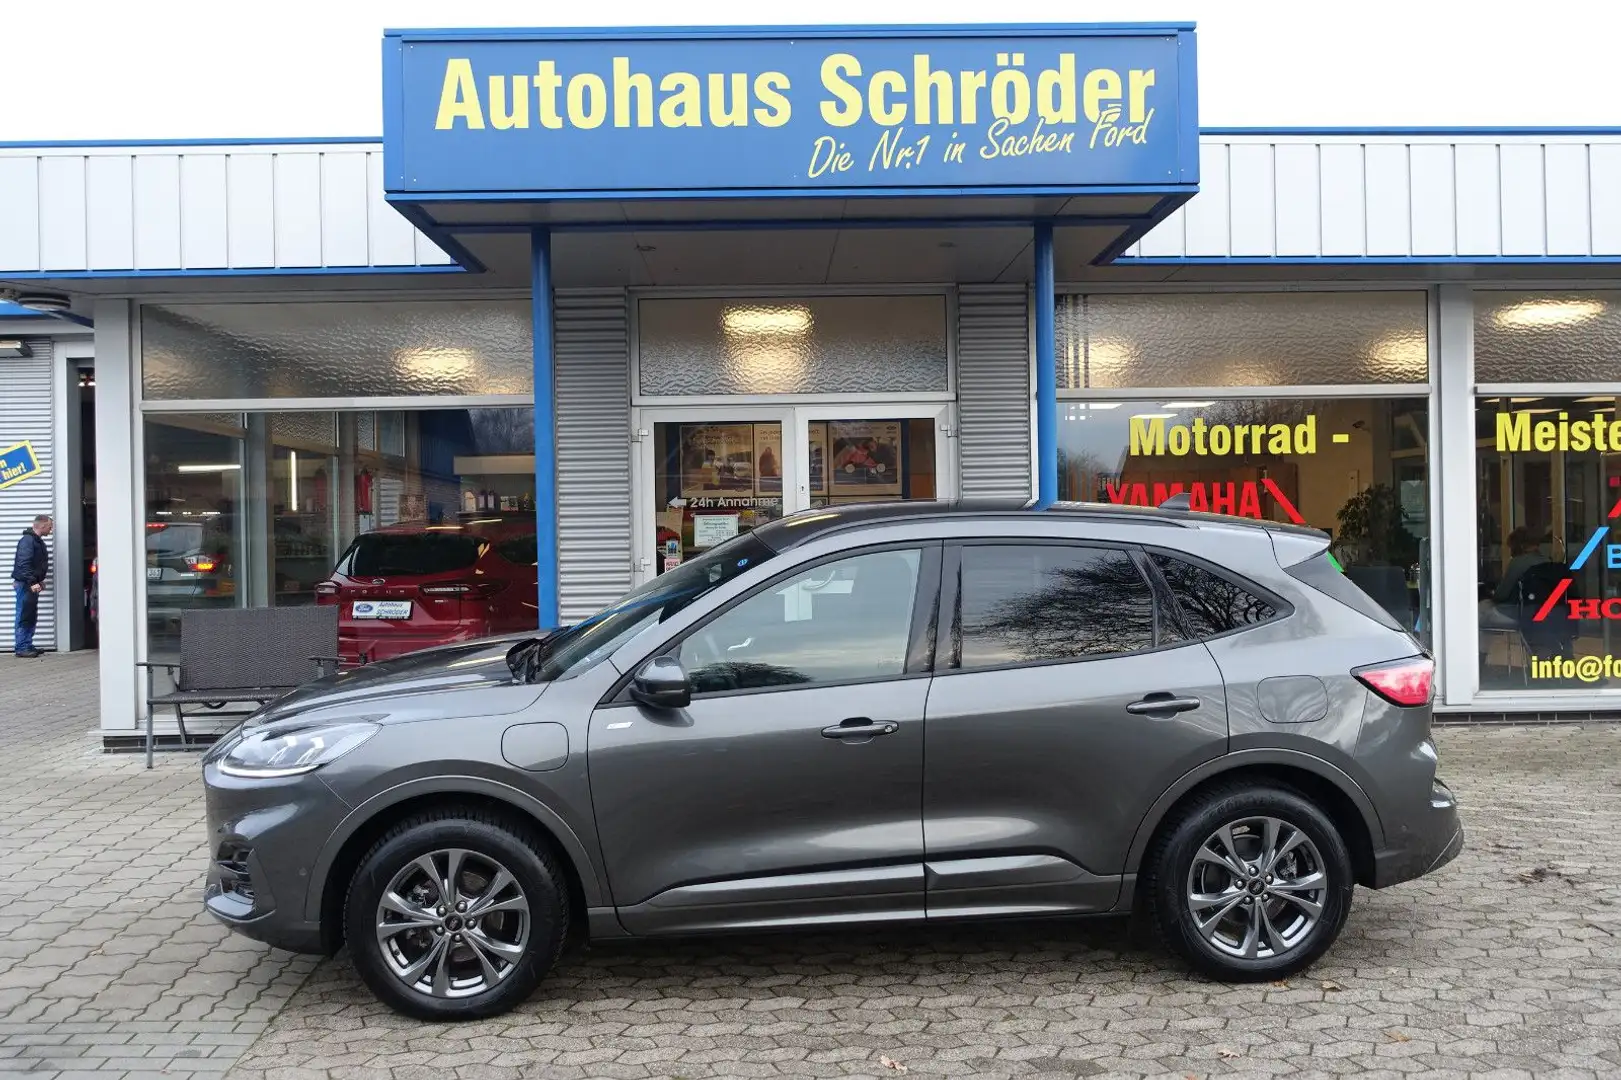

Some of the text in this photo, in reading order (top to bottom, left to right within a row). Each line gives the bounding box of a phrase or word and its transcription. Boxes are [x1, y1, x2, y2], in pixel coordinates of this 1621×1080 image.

[435, 52, 1155, 130] Autohaus Schröder
[807, 104, 1155, 179] Die Nr.1 in Sachen Ford
[1129, 414, 1317, 456] Motorrad
[690, 496, 779, 508] 24h Annahme
[1106, 481, 1262, 520] YAMAHA
